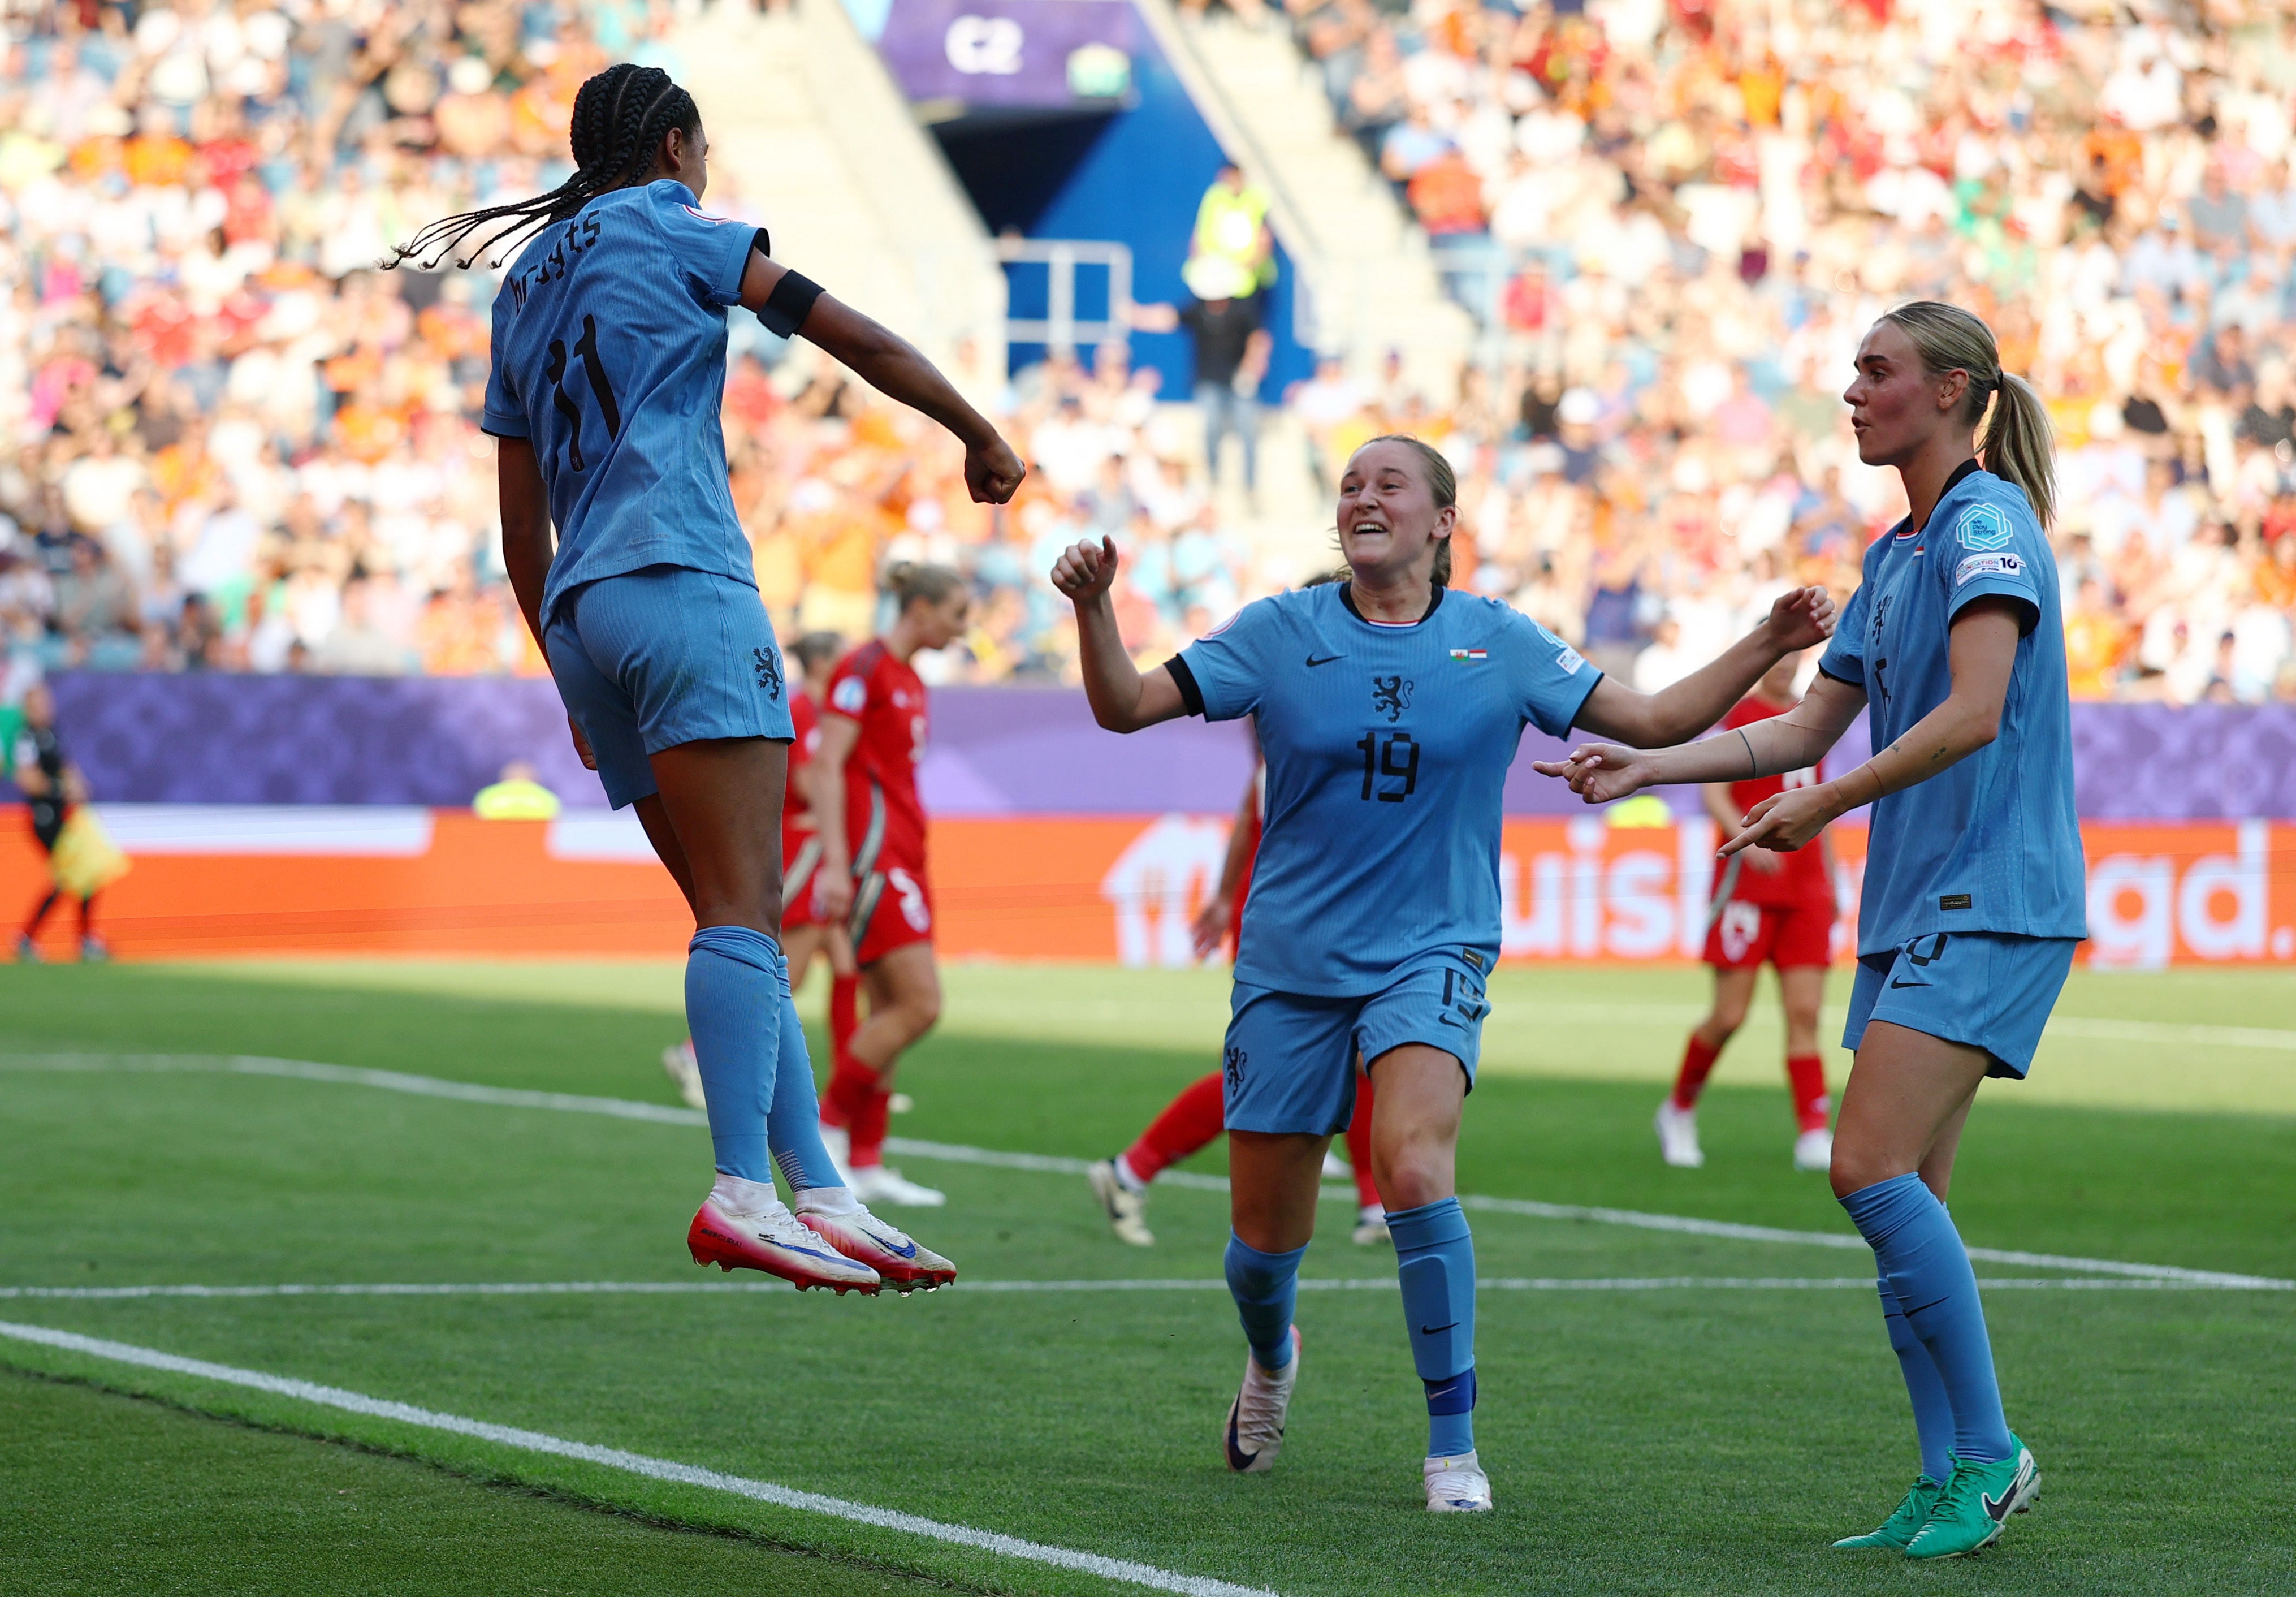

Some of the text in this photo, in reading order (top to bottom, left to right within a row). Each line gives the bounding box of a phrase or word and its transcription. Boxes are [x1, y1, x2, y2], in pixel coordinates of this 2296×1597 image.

[945, 15, 1024, 75] C2
[546, 314, 621, 472] 11
[1357, 732, 1420, 802] 19
